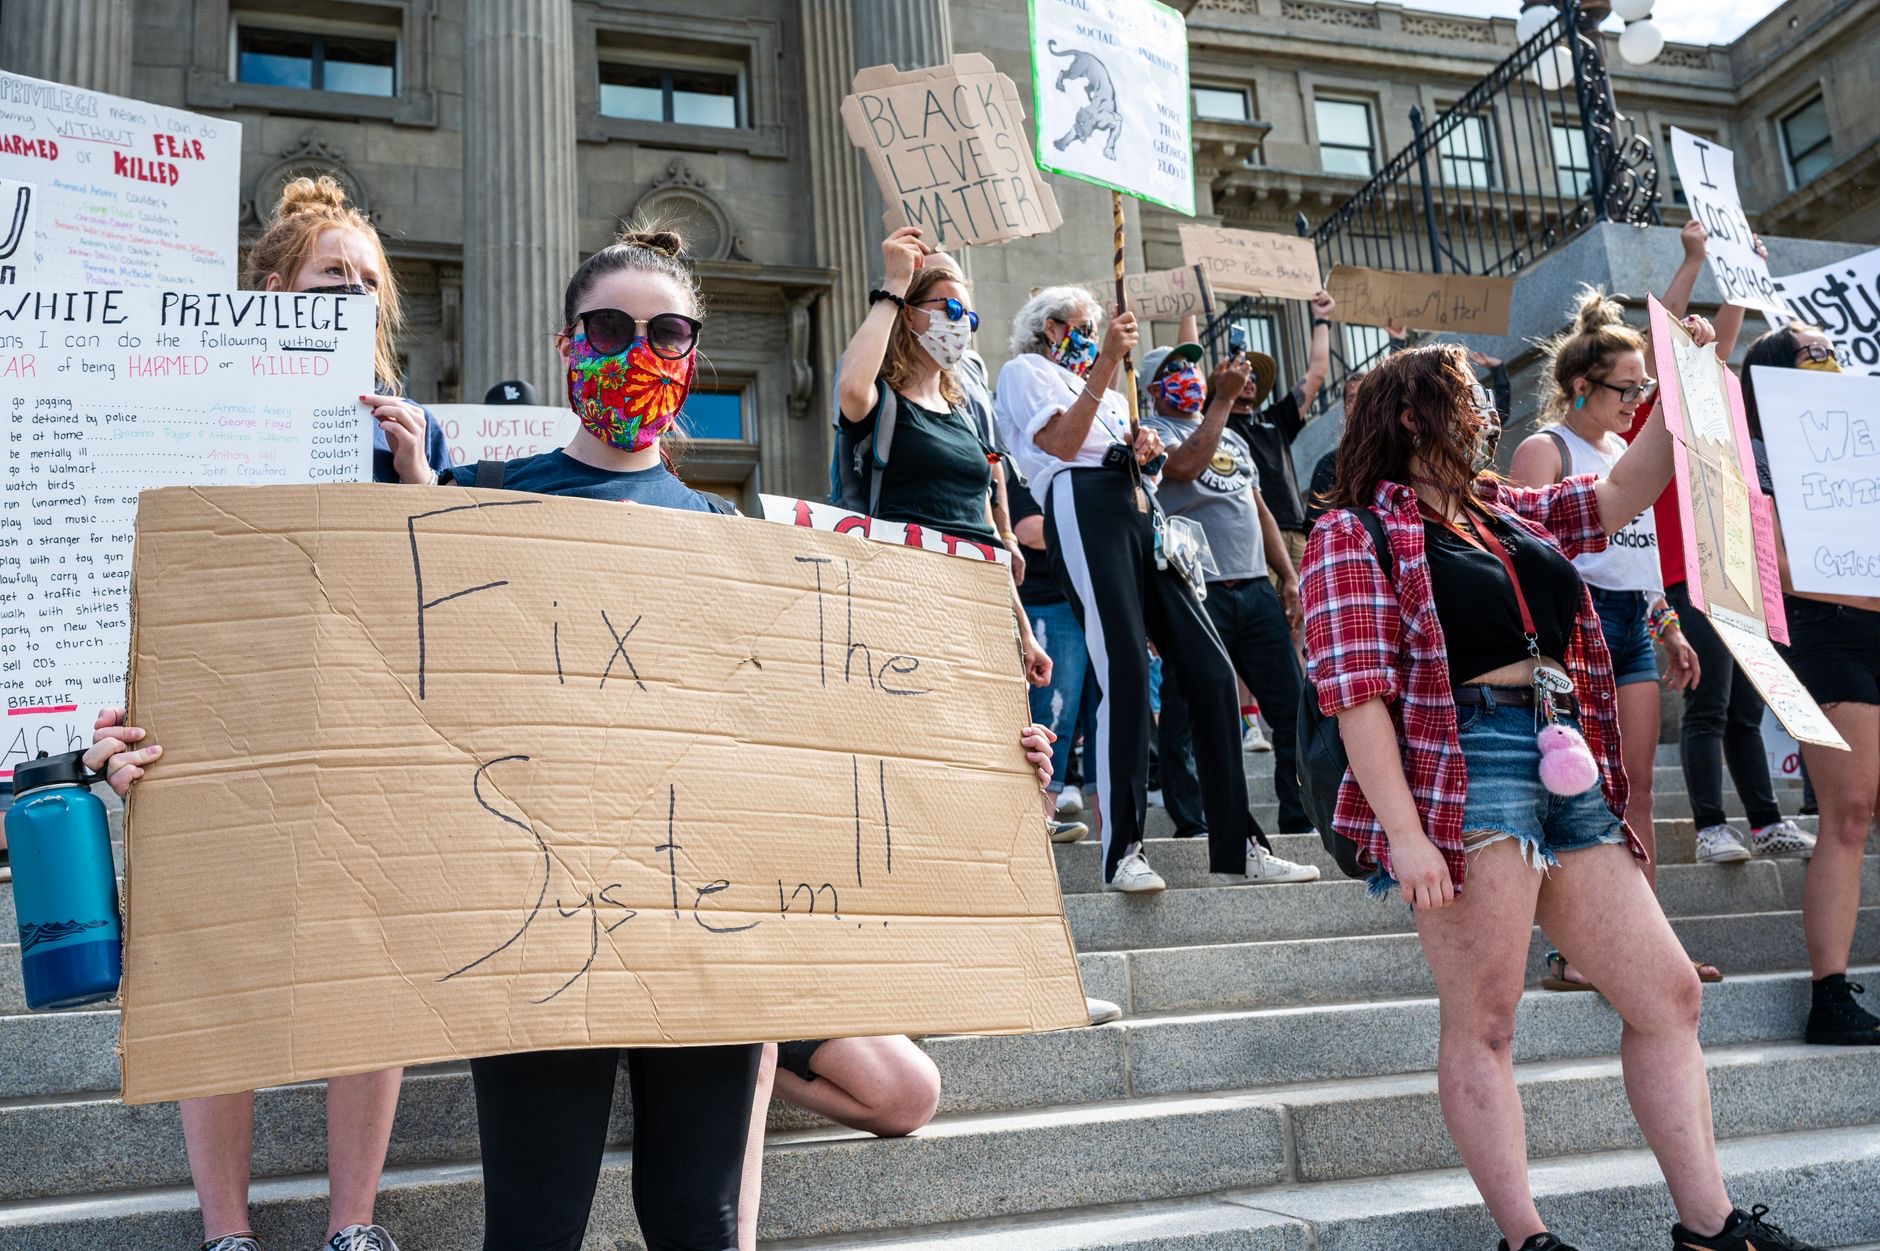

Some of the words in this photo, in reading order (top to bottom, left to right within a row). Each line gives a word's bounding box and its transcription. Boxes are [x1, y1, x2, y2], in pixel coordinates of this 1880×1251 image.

[1076, 24, 1115, 46] SOCIAL
[860, 84, 1008, 147] BLACK
[46, 117, 135, 147] WITHOUT
[153, 134, 206, 160] FEAR
[113, 151, 179, 187] KILLED
[886, 133, 1020, 194] LIVES
[1157, 158, 1186, 179] FLOYD
[1693, 140, 1718, 190] I
[902, 176, 1041, 242] MATTER
[0, 291, 128, 324] WHITE
[161, 292, 348, 331] PRIVILEGE
[1137, 292, 1196, 315] FLOYD
[39, 331, 48, 348] I
[65, 335, 99, 347] can
[118, 332, 141, 348] do
[156, 333, 180, 347] the
[200, 331, 267, 352] following
[279, 336, 339, 352] without
[0, 354, 36, 378] AR
[58, 357, 72, 372] of
[82, 359, 116, 380] being
[129, 354, 208, 378] HARMED
[219, 361, 233, 369] or
[252, 355, 329, 376] KILLED
[12, 397, 25, 406] go
[35, 397, 72, 410] jogging
[12, 412, 23, 423] be
[32, 414, 79, 424] detained
[86, 413, 98, 426] by
[105, 413, 137, 425] police
[219, 416, 257, 427] George
[264, 419, 292, 430] Floyd
[477, 418, 555, 437] JUSTICE
[10, 432, 22, 442] be
[33, 431, 45, 441] at
[53, 430, 84, 440] home
[10, 449, 20, 459] be
[30, 448, 72, 460] mentally
[79, 448, 88, 457] ill
[449, 446, 465, 465] O
[9, 467, 20, 477] go
[30, 463, 40, 473] to
[200, 464, 228, 477] John
[236, 464, 287, 476] Crawford
[5, 481, 38, 491] watch
[47, 480, 75, 490] birds
[32, 494, 87, 508] (unarmed)
[94, 496, 115, 505] from
[1, 517, 22, 531] play
[33, 516, 52, 526] loud
[65, 515, 97, 524] music
[40, 535, 80, 547] stranger
[90, 533, 103, 543] for
[111, 533, 134, 544] help
[0, 556, 21, 569] play
[30, 556, 50, 565] with
[59, 556, 66, 564] a
[75, 553, 93, 565] toy
[104, 553, 124, 565] gun
[51, 573, 78, 585] carry
[88, 572, 95, 580] a
[0, 592, 17, 604] get
[44, 588, 81, 599] traffic
[409, 499, 647, 700] Fix
[794, 555, 934, 696] The
[39, 607, 63, 617] with
[1, 625, 31, 638] party
[40, 625, 54, 633] on
[0, 644, 16, 655] go
[26, 642, 39, 651] to
[56, 637, 103, 649] church
[3, 660, 21, 671] sell
[35, 678, 53, 688] out
[65, 678, 83, 689] my
[8, 693, 73, 709] BREATHE
